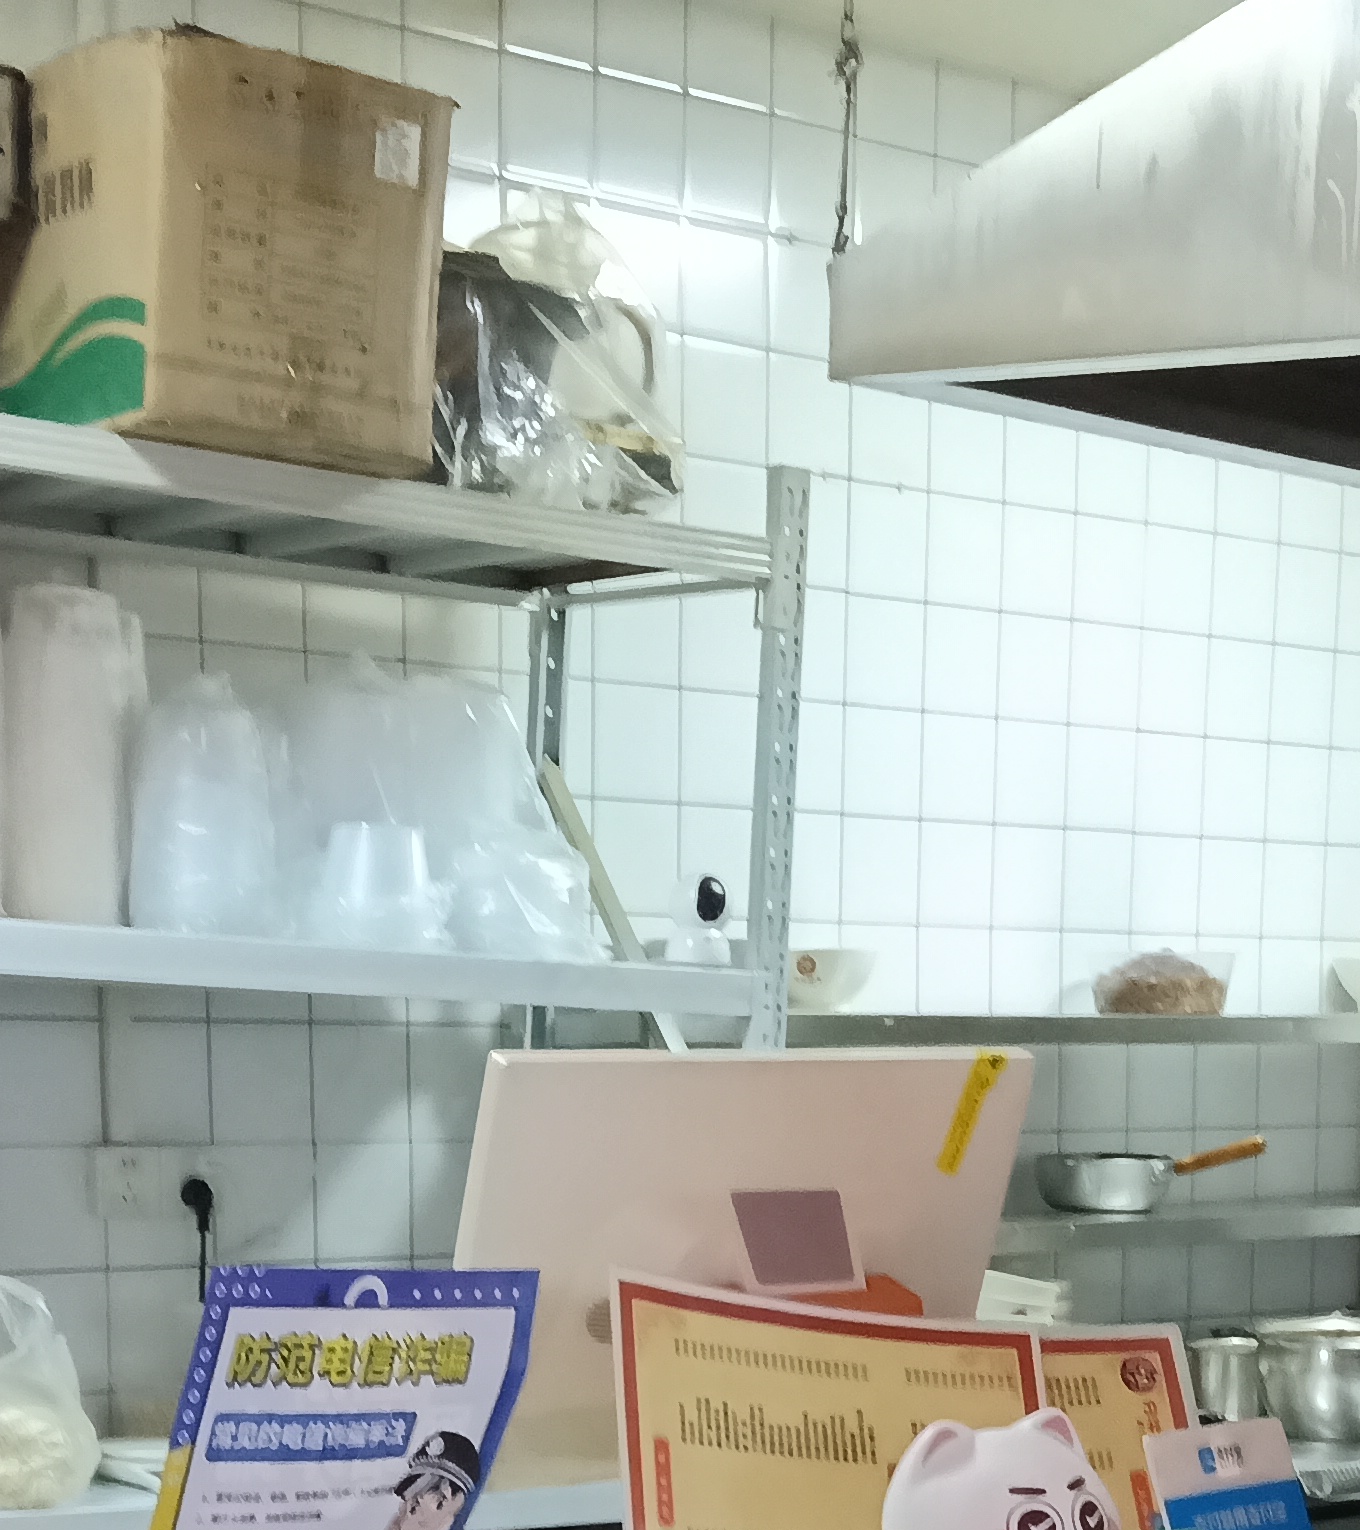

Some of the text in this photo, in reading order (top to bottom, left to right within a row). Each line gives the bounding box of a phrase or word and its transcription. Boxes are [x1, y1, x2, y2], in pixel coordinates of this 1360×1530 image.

[226, 1330, 474, 1388] 防范电信诈骗
